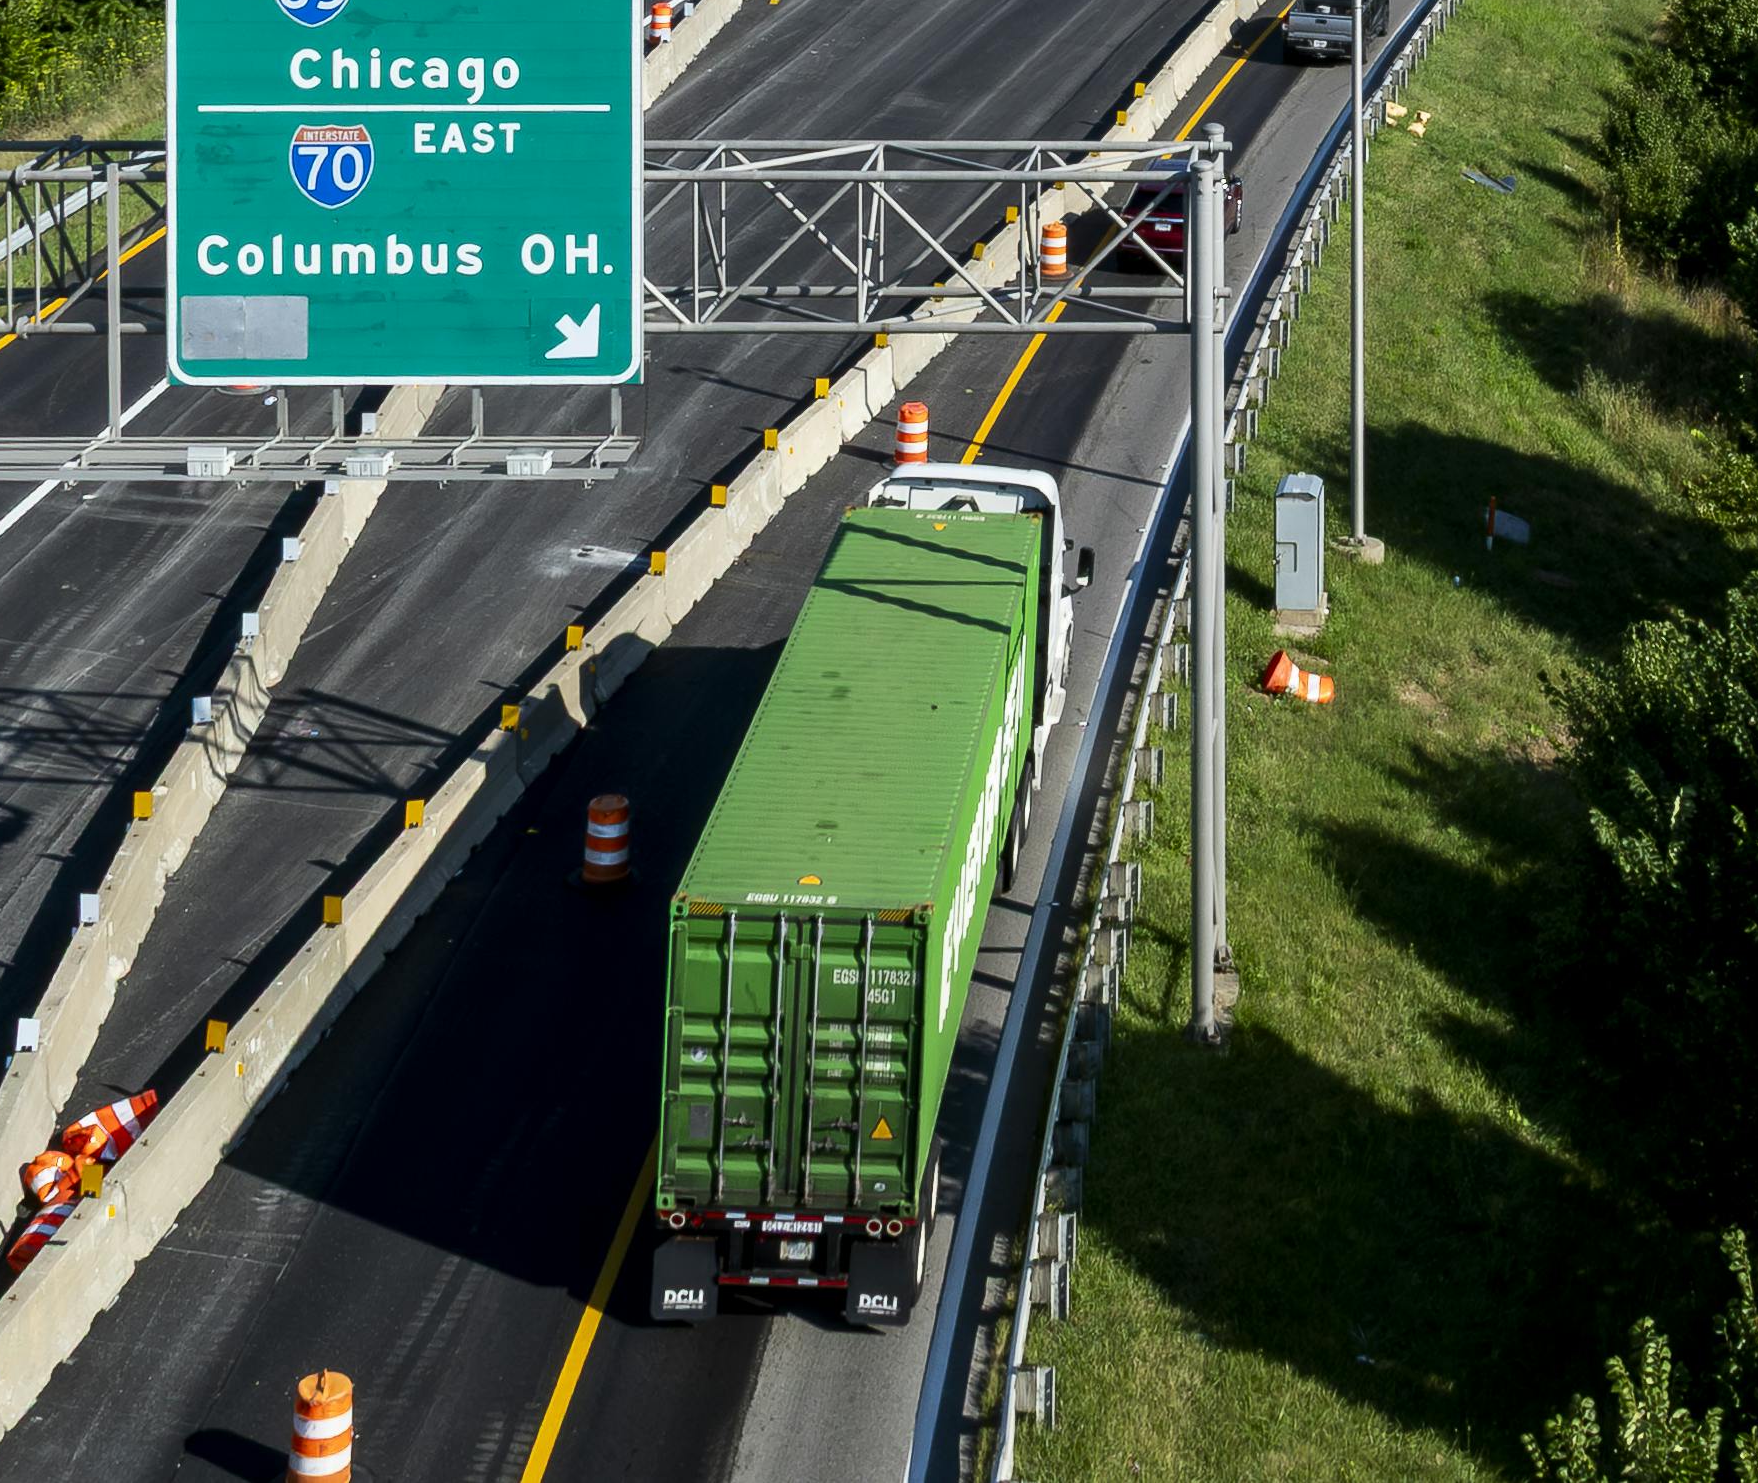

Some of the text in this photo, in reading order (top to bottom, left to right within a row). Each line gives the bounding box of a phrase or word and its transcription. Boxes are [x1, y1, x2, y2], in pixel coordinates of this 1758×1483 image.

[290, 47, 521, 105] Chicago
[302, 129, 360, 142] INTERSTATE
[413, 122, 521, 154] EAST
[297, 146, 364, 192] 70
[197, 234, 614, 276] Columbus OH.
[663, 1289, 704, 1304] DCLI
[858, 1293, 899, 1309] DCLI
